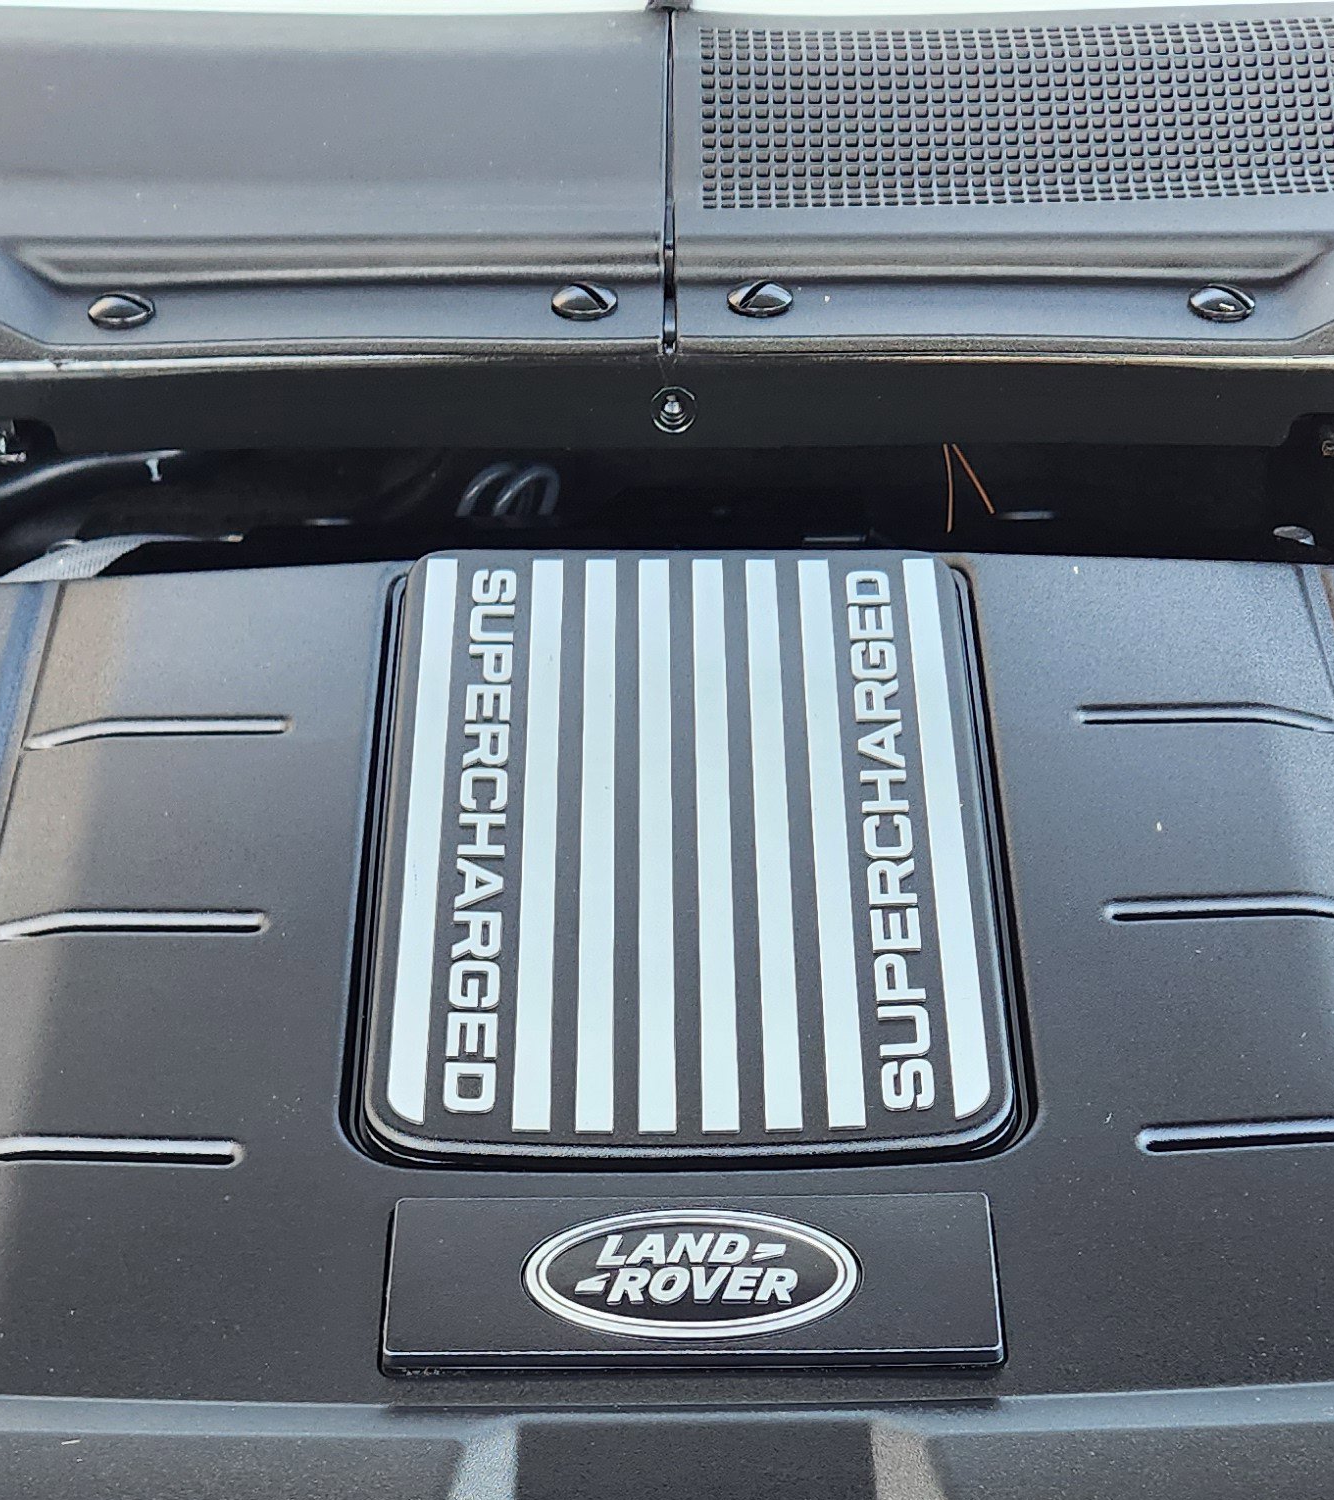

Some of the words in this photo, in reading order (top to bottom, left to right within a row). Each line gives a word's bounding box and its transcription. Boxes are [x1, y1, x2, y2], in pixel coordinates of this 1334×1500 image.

[443, 568, 517, 1115] SUPERCHARGED
[845, 569, 936, 1113] SUPERCHARGED
[596, 1232, 750, 1268] LAND
[606, 1267, 799, 1305] ROVER
